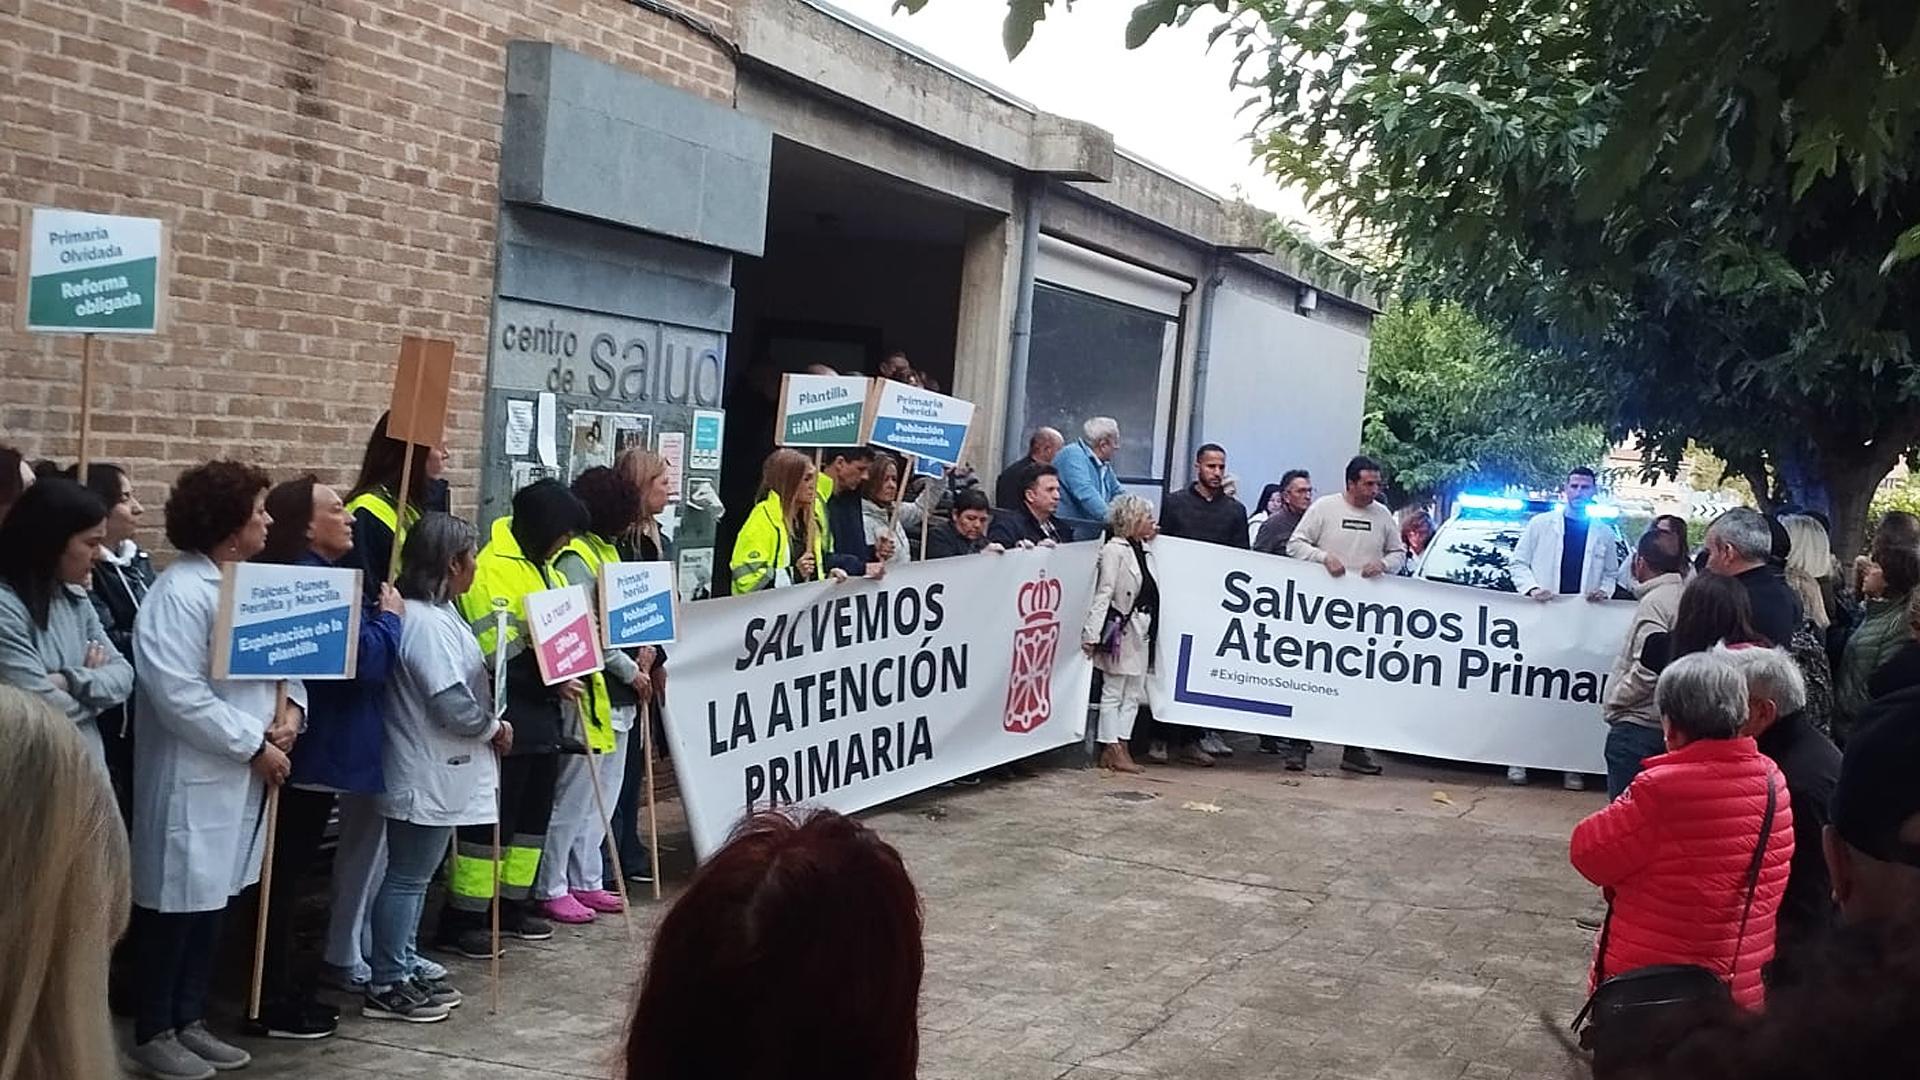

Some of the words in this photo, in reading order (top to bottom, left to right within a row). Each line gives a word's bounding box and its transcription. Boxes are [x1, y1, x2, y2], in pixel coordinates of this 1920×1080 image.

[49, 227, 109, 245] Primaria
[60, 245, 123, 264] Olvidada
[61, 275, 129, 299] Reforma
[75, 291, 142, 317] obligada
[503, 320, 578, 357] centro
[547, 358, 575, 393] de
[588, 323, 723, 407] salud
[799, 386, 849, 406] Plantilla
[896, 394, 944, 409] Primaria
[902, 405, 939, 418] herida
[887, 432, 950, 448] desatendida
[894, 421, 945, 436] Población
[1220, 569, 1464, 641] Salvemos
[1477, 604, 1520, 650] la
[238, 625, 314, 653] Explotación
[314, 621, 330, 636] de
[330, 618, 344, 633] la
[735, 582, 945, 672] SALVEMOS
[268, 640, 319, 666] plantilla
[1215, 616, 1442, 687] Atención
[1209, 667, 1340, 697] #ExigimosSoluciones
[707, 689, 758, 757] LA
[767, 636, 969, 739] ATENCIÓN
[745, 715, 934, 813] PRIMARIA
